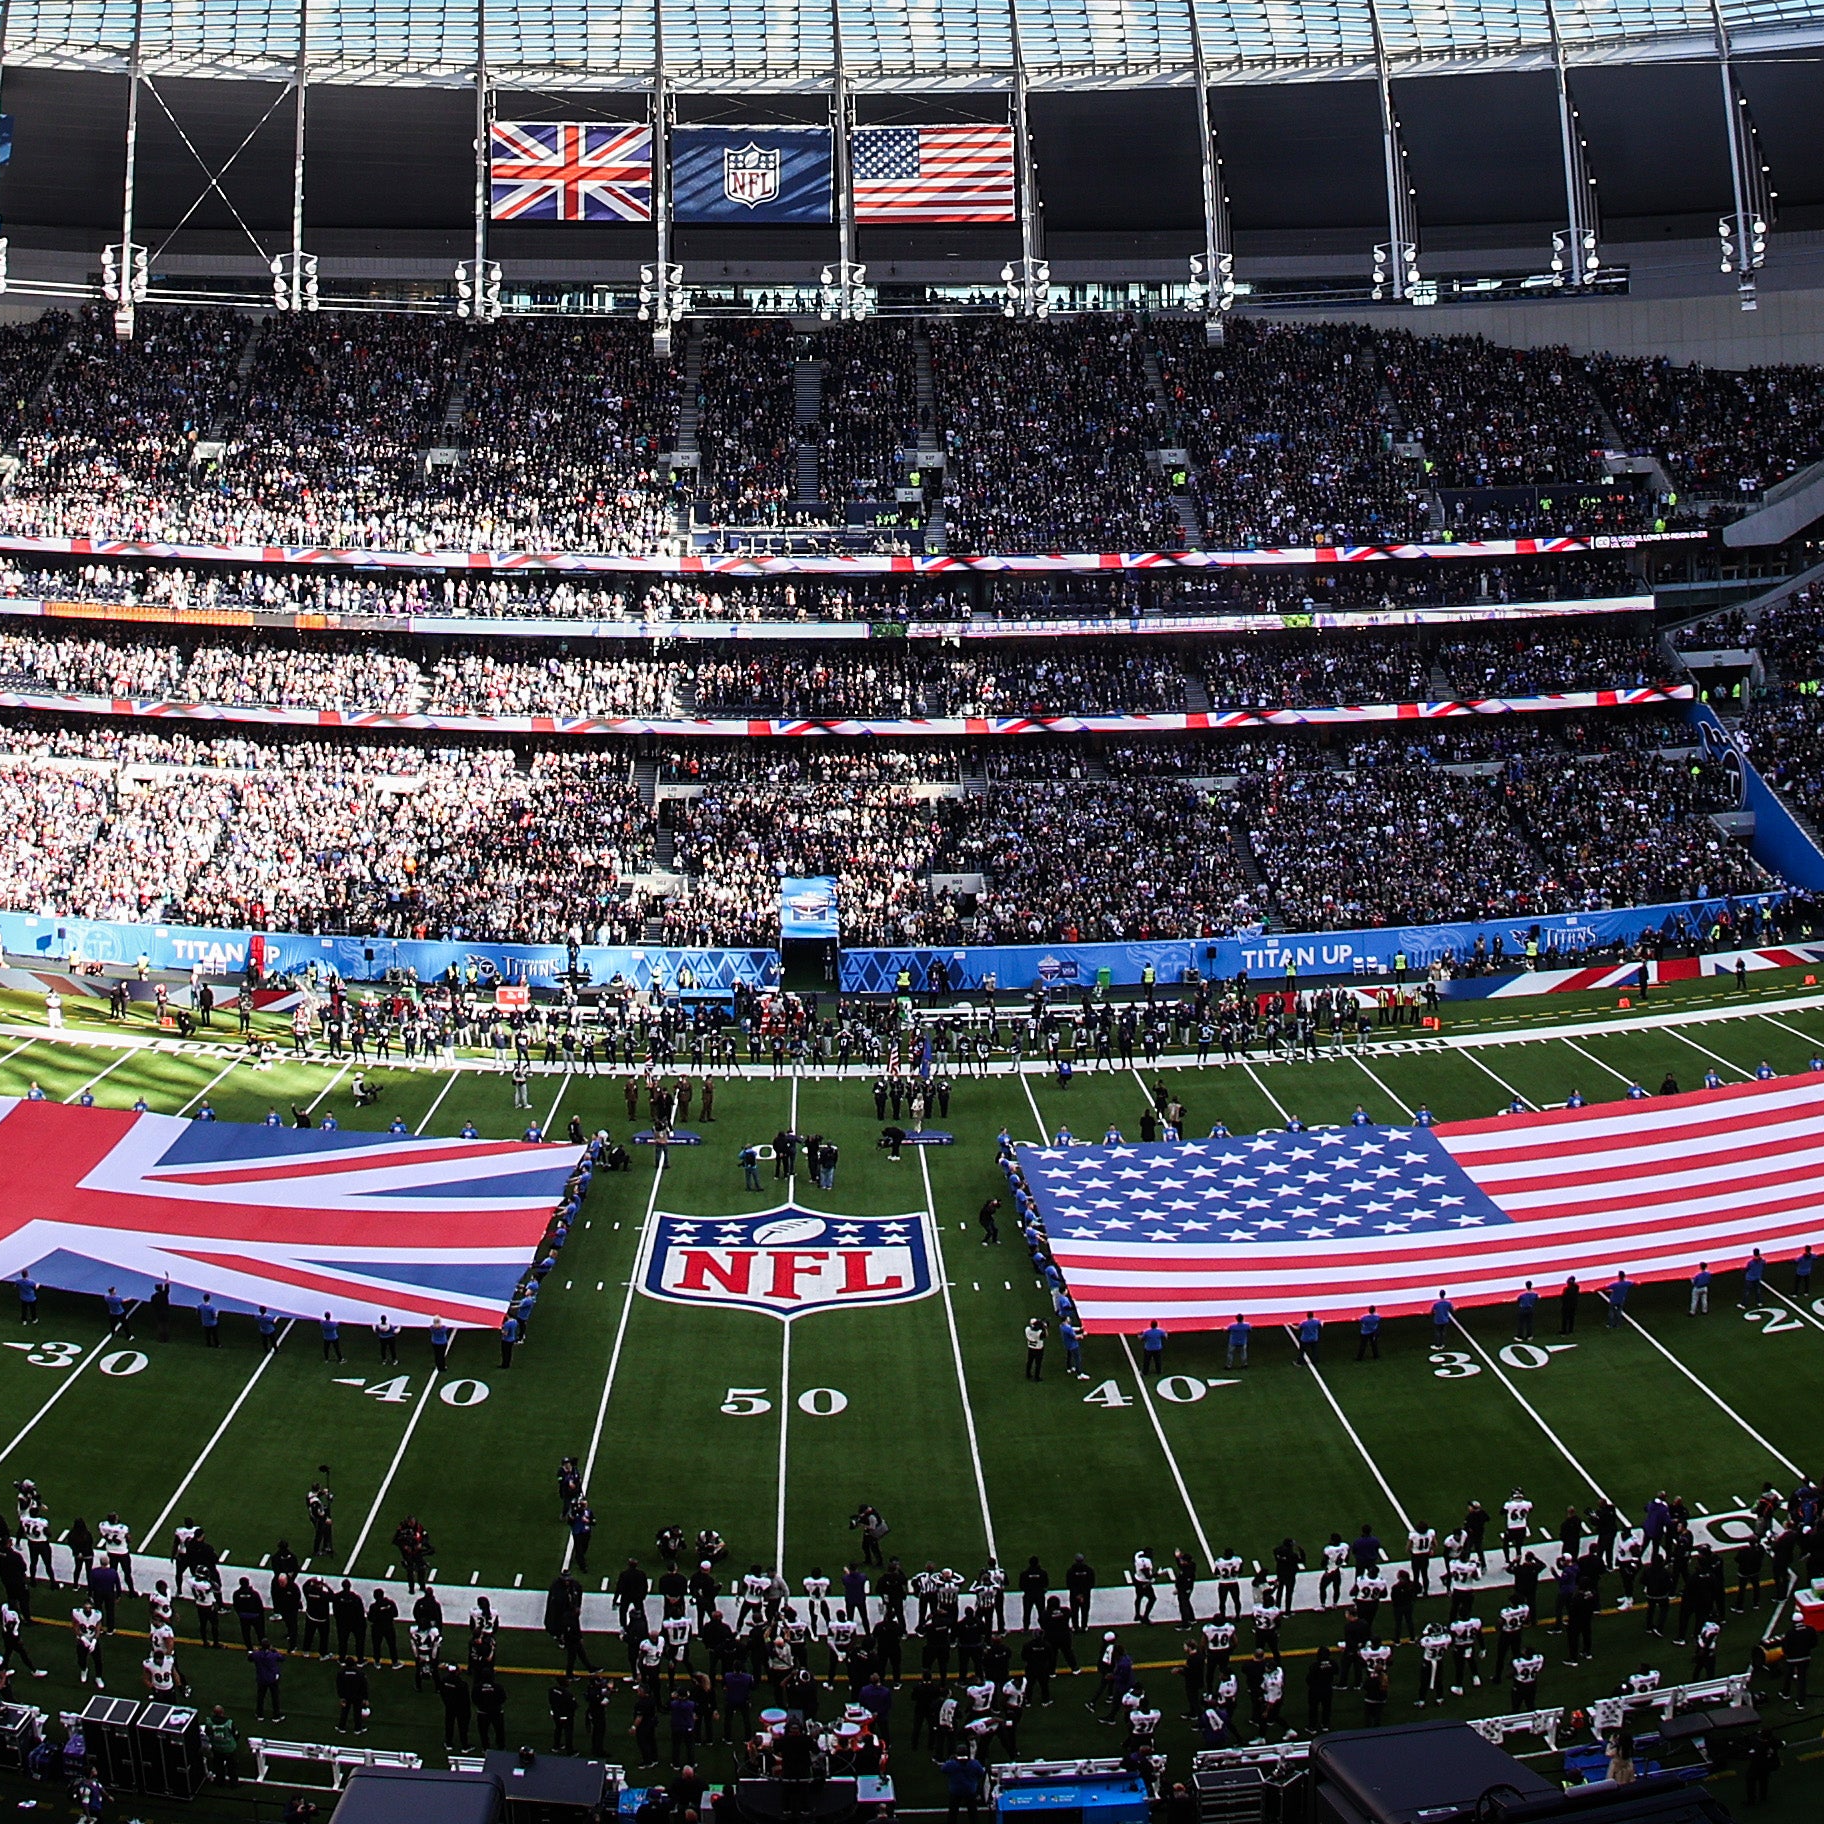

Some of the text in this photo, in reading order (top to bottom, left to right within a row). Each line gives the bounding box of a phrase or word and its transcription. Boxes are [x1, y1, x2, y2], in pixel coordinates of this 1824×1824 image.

[730, 171, 779, 198] NFL
[172, 939, 244, 965] TITAN
[1542, 926, 1598, 947] TITANS
[1241, 944, 1354, 969] TITAN UP
[672, 1249, 903, 1301] NFL
[25, 1341, 150, 1378] 30
[1428, 1342, 1552, 1380] 30
[363, 1373, 492, 1408] 40
[719, 1386, 849, 1418] 50
[1081, 1373, 1208, 1409] 40
[981, 1693, 990, 1707] 7
